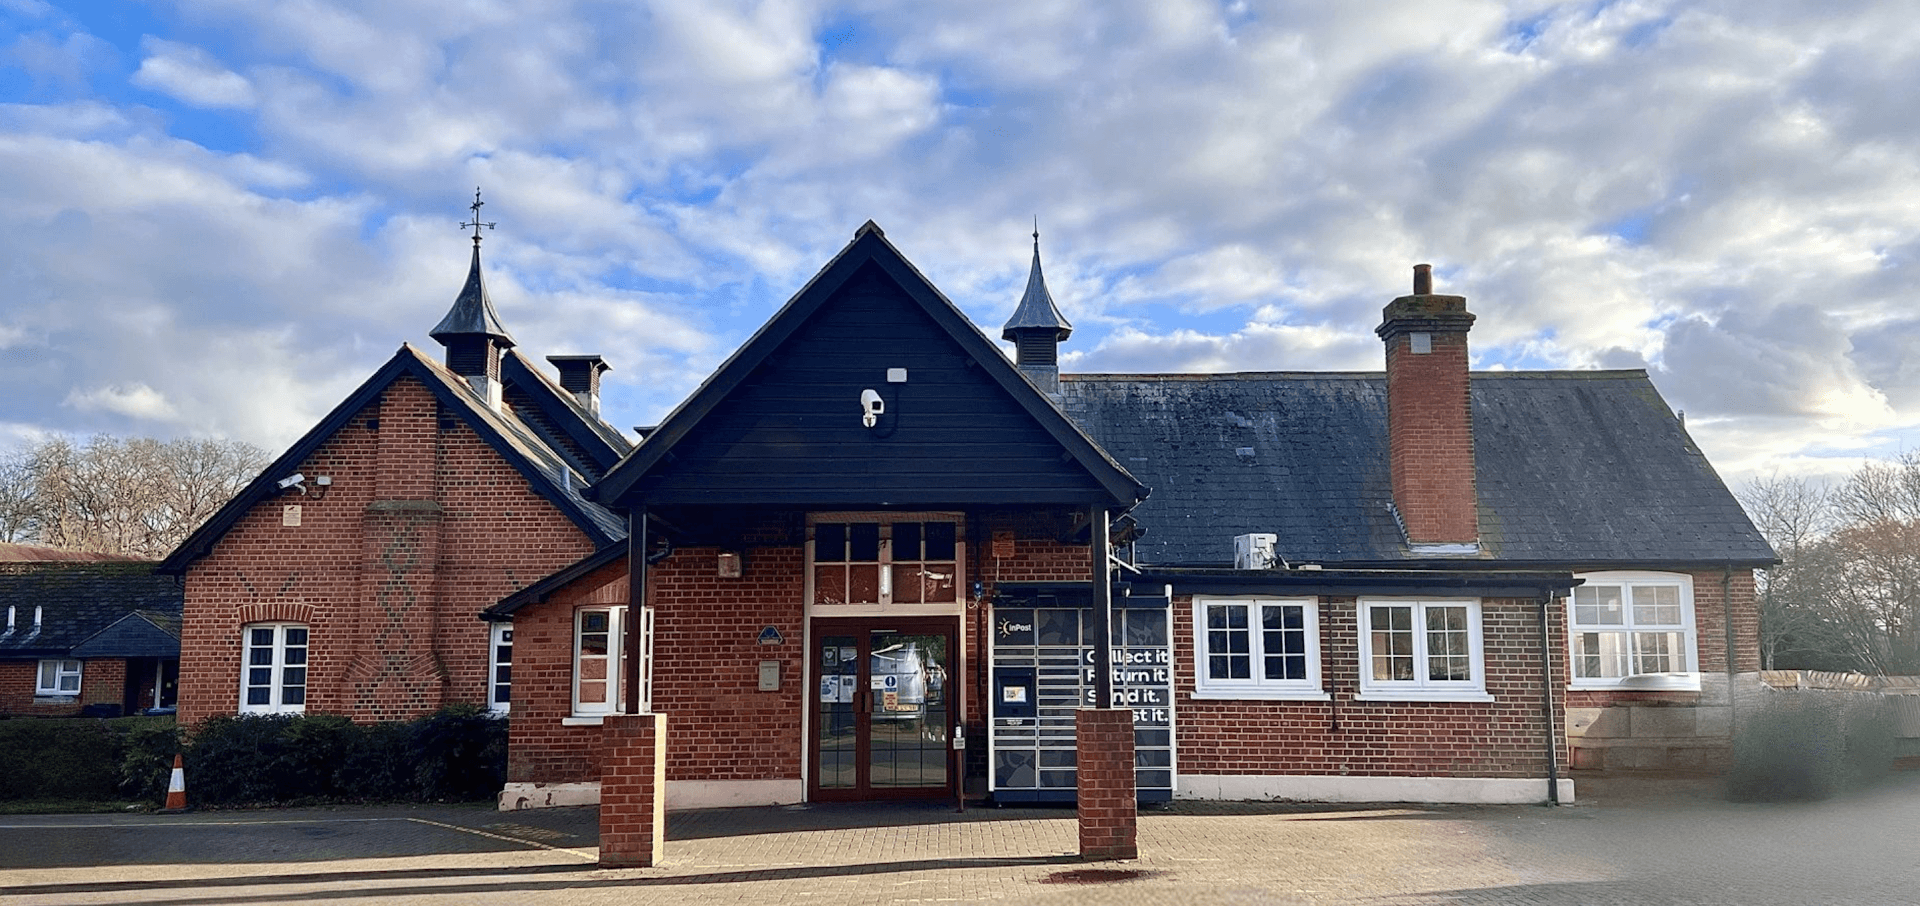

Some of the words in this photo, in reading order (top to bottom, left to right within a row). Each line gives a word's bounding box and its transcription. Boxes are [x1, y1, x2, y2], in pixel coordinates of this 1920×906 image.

[1086, 650, 1152, 663] Cllect
[1087, 668, 1150, 682] Rturn
[1153, 668, 1169, 682] it.
[1087, 689, 1139, 702] Snd
[1143, 689, 1160, 702] it.
[1152, 708, 1169, 721] it.
